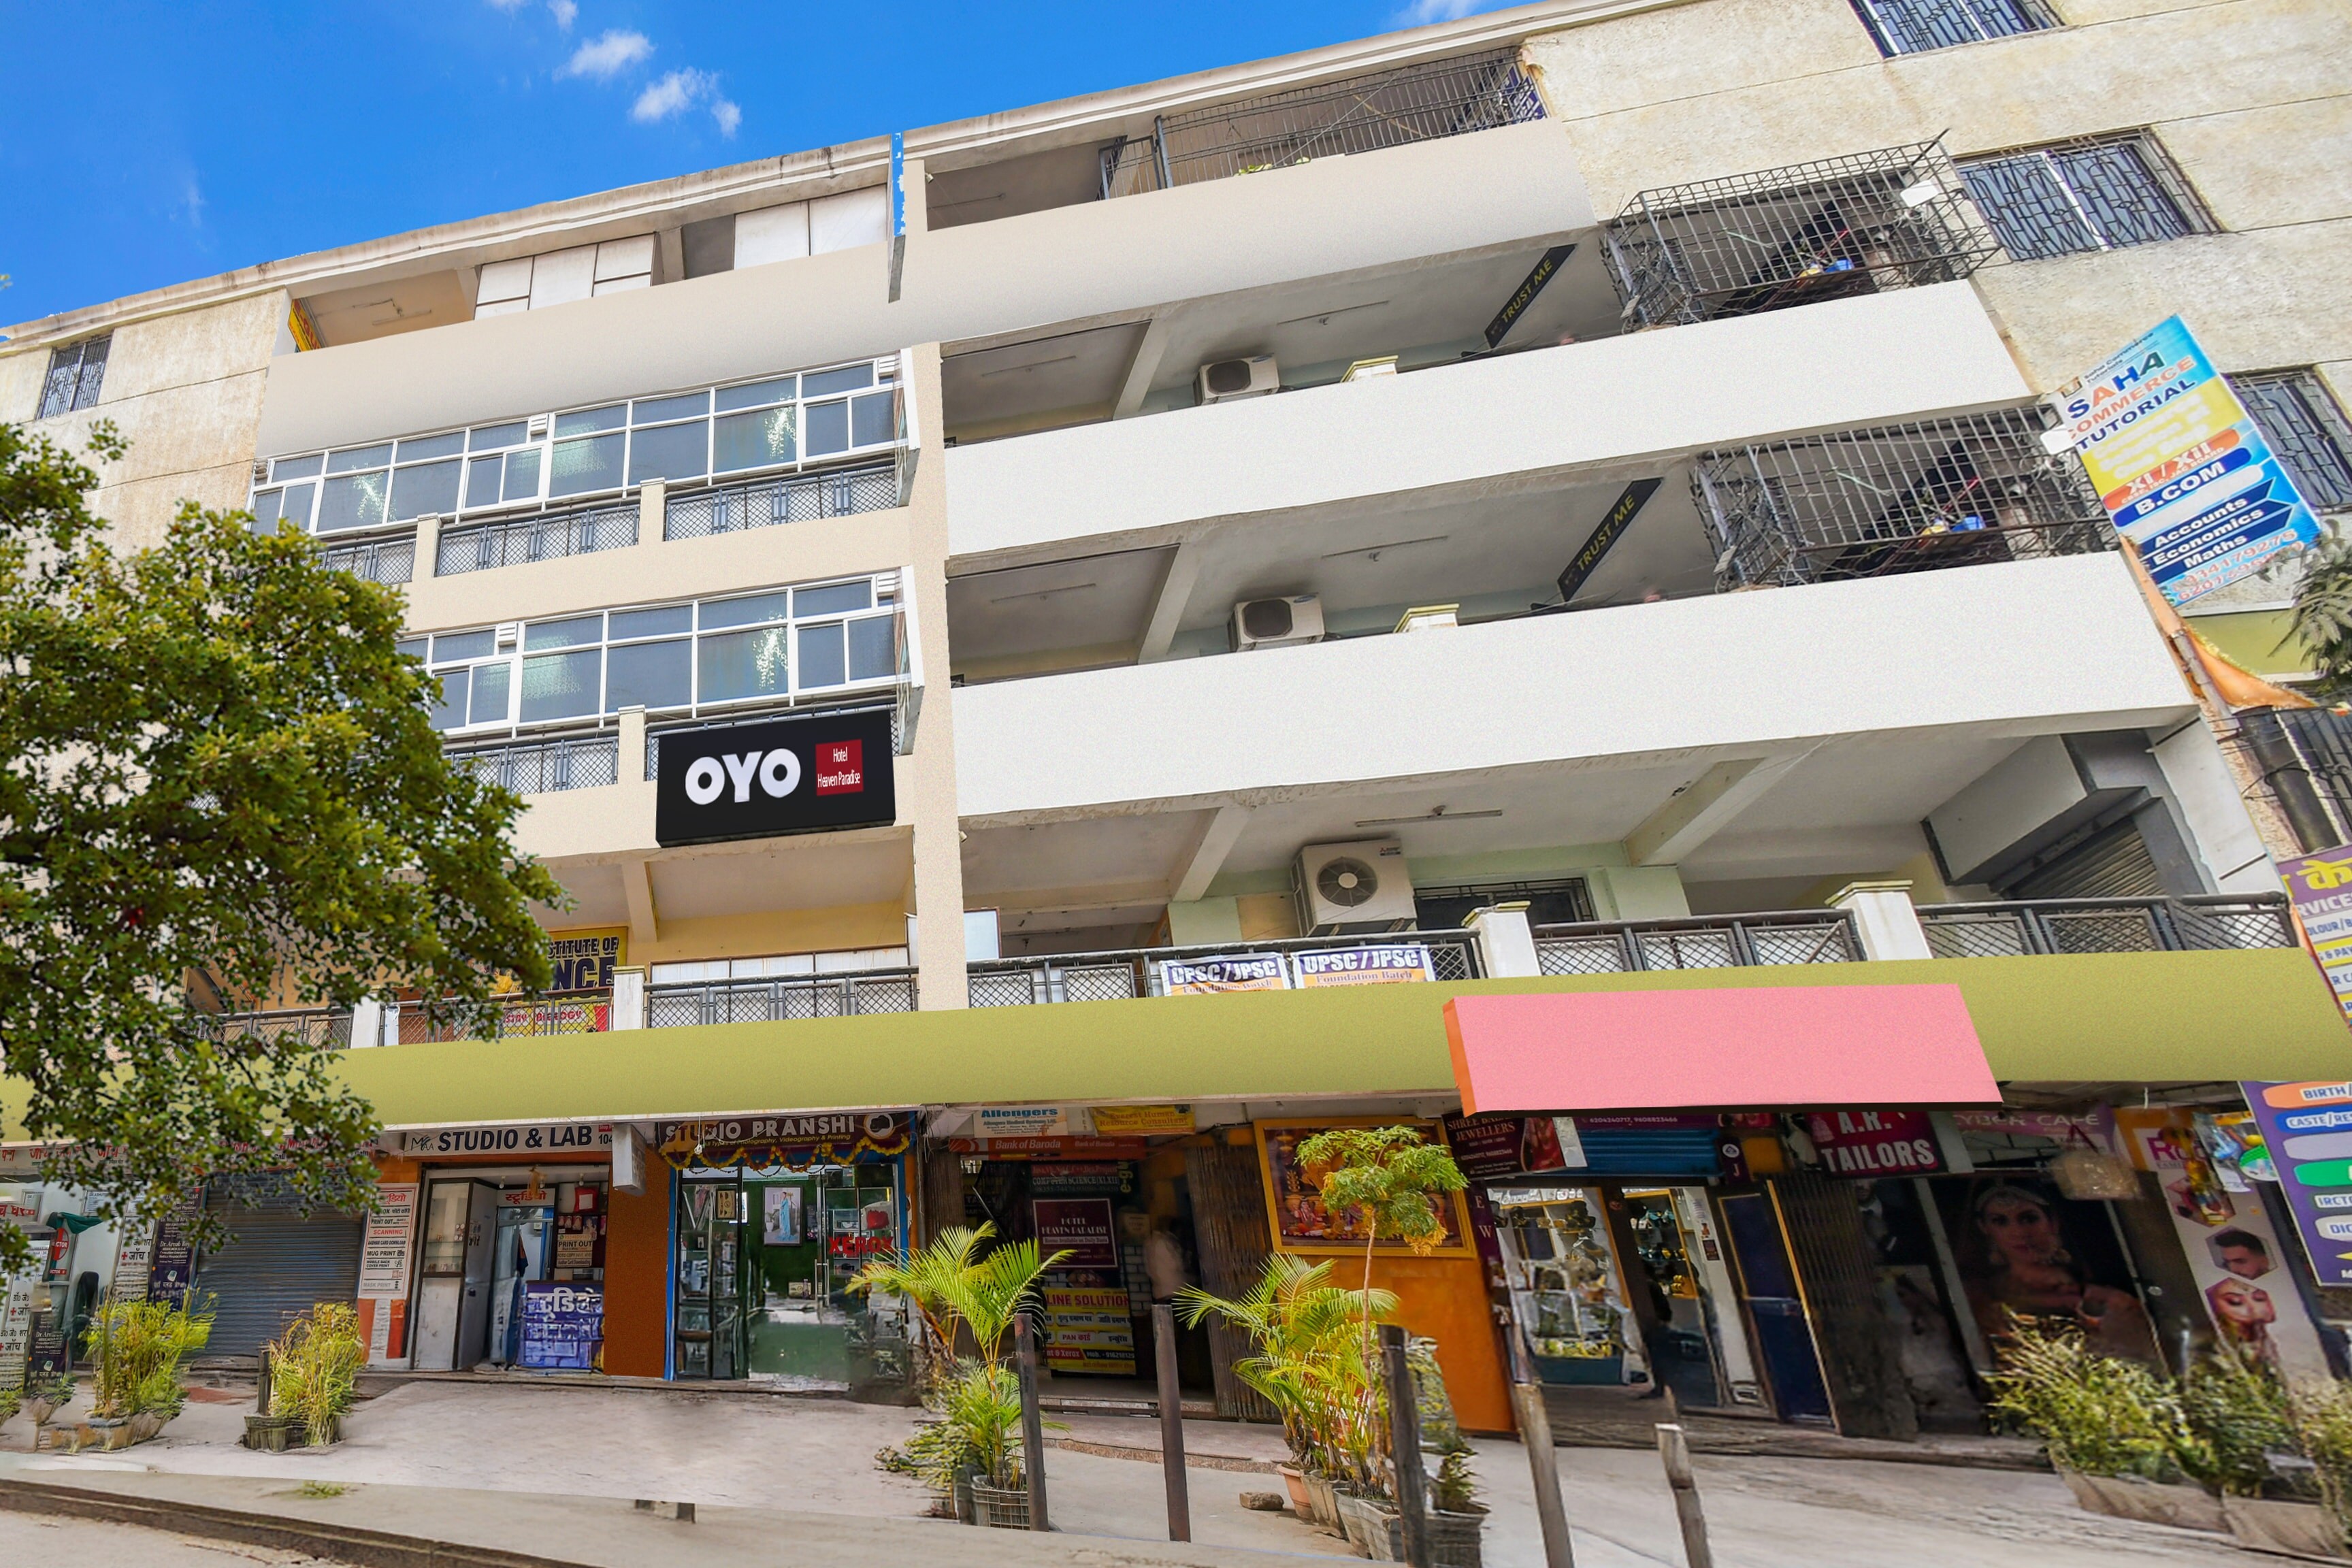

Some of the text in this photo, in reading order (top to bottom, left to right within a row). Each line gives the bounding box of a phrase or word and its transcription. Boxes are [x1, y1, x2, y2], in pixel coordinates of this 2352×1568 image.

[1501, 259, 1552, 323] TRUST ME
[2067, 351, 2166, 419] SAHA
[2076, 378, 2195, 451] TUTORIAL
[2127, 470, 2155, 496] XI
[2173, 441, 2212, 468] XII
[2136, 461, 2226, 517] B.COM
[1576, 495, 1635, 571] TRUST ME
[2154, 497, 2248, 548] Accounts
[2153, 508, 2264, 566] Economics
[2183, 534, 2248, 568] Maths
[832, 747, 848, 763] Hotel
[685, 748, 801, 805] OYO
[817, 769, 861, 789] Heaven Paradise
[2296, 895, 2352, 917] RVICE
[602, 936, 619, 955] OF
[1172, 963, 1221, 985] UPSC
[1233, 960, 1278, 981] JPSC
[1303, 953, 1358, 973] UPSC
[1370, 949, 1420, 968] JPSC
[1183, 983, 1241, 994] Foundation
[1316, 970, 1413, 984] Foundation Batch
[981, 1109, 1058, 1118] Allengers
[1099, 1118, 1139, 1127] Resource
[1141, 1116, 1188, 1126] Consultant
[1144, 1110, 1175, 1118] Human
[438, 1129, 519, 1152] STUDIO
[524, 1127, 543, 1148] &
[549, 1126, 593, 1147] LAB
[665, 1115, 855, 1143] STUDIO PRANSHI
[779, 1135, 819, 1145] Videography
[827, 1133, 851, 1142] Printing
[1455, 1122, 1516, 1143] JEWELLERS
[995, 1139, 1061, 1149] Bank of Baroda
[1820, 1139, 1936, 1173] TAILORS
[1068, 1176, 1096, 1185] SCIENCE
[828, 1235, 894, 1256] XEROX
[1075, 1294, 1130, 1307] SOLUTION
